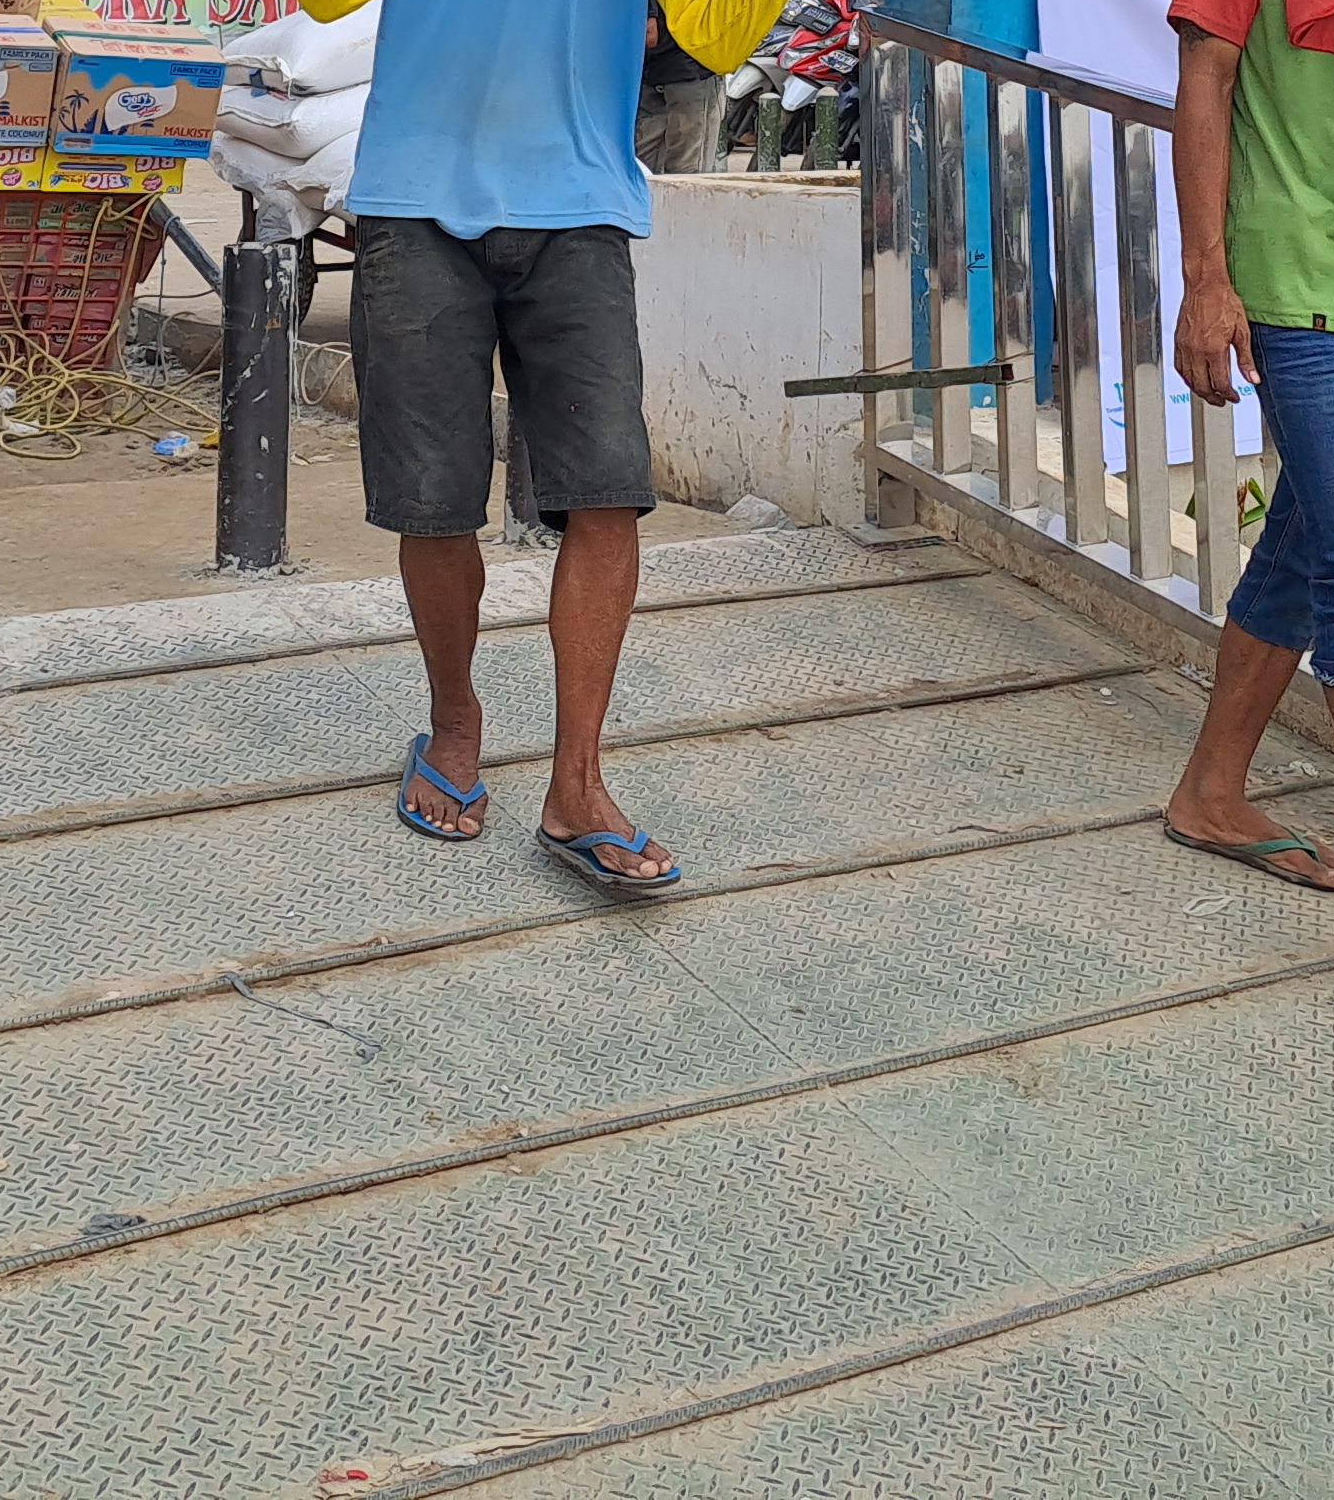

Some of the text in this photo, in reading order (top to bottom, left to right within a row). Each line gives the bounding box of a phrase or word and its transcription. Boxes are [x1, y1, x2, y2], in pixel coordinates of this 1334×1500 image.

[31, 51, 50, 60] PACK
[8, 129, 45, 139] COCONUT
[164, 126, 212, 139] MALKIST
[83, 172, 126, 190] BIG
